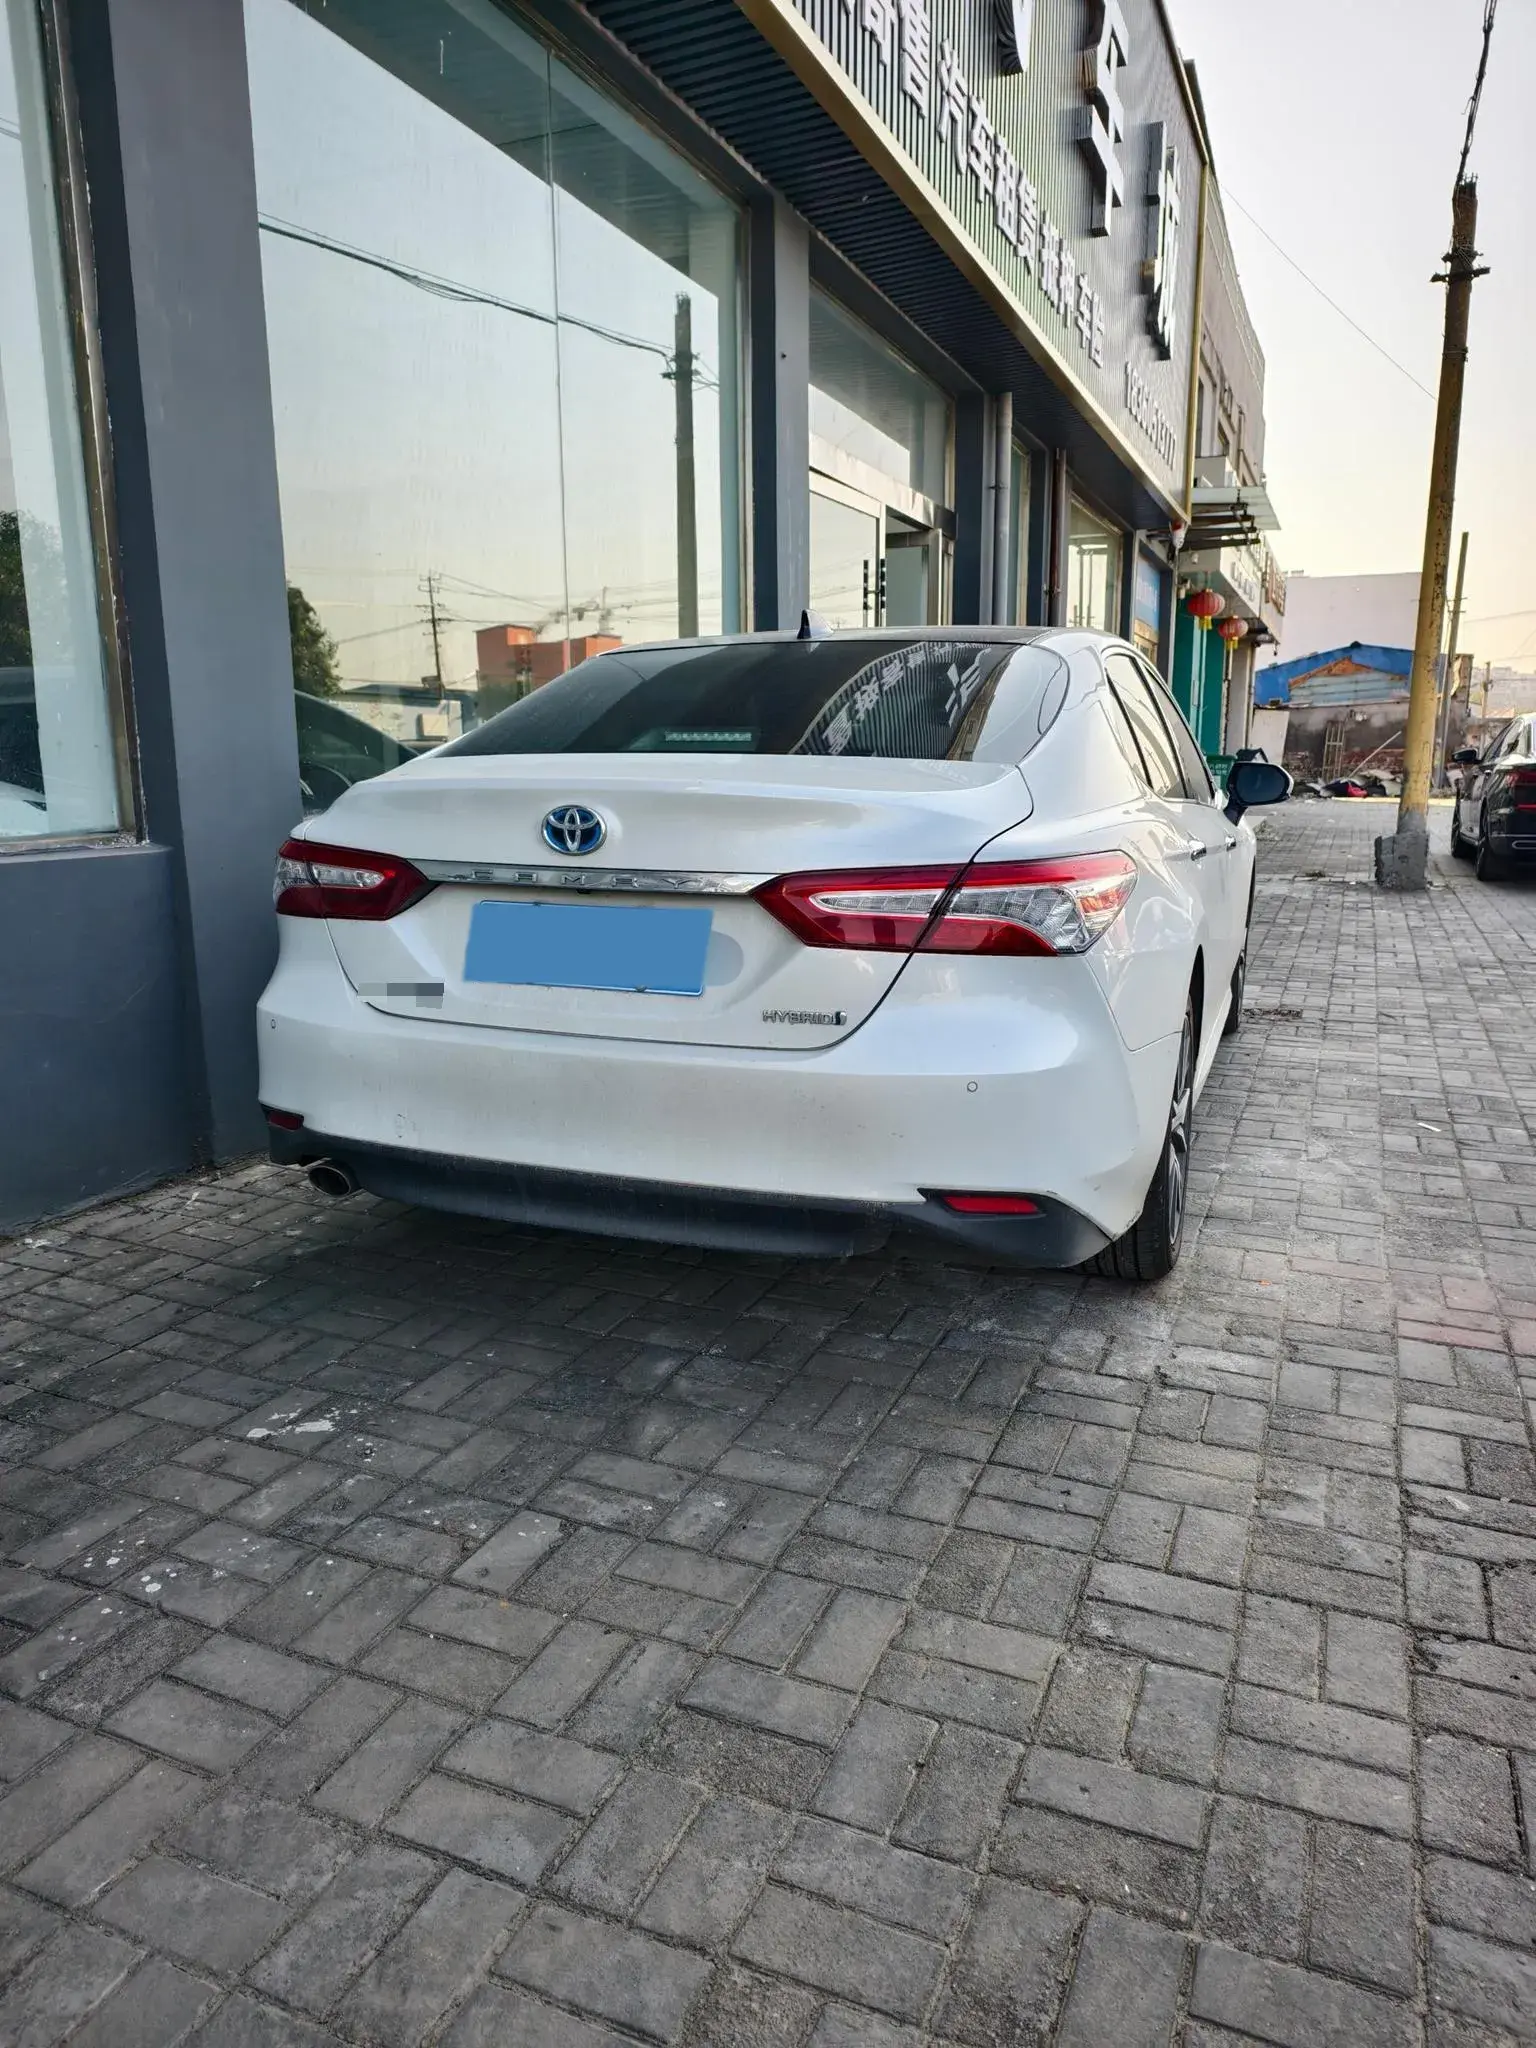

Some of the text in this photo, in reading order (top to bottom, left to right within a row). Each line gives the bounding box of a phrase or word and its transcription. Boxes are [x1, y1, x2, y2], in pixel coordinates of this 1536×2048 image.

[937, 38, 1037, 277] 汽车租赁
[471, 867, 692, 890] CAMRY
[762, 1010, 835, 1025] HYBRID
